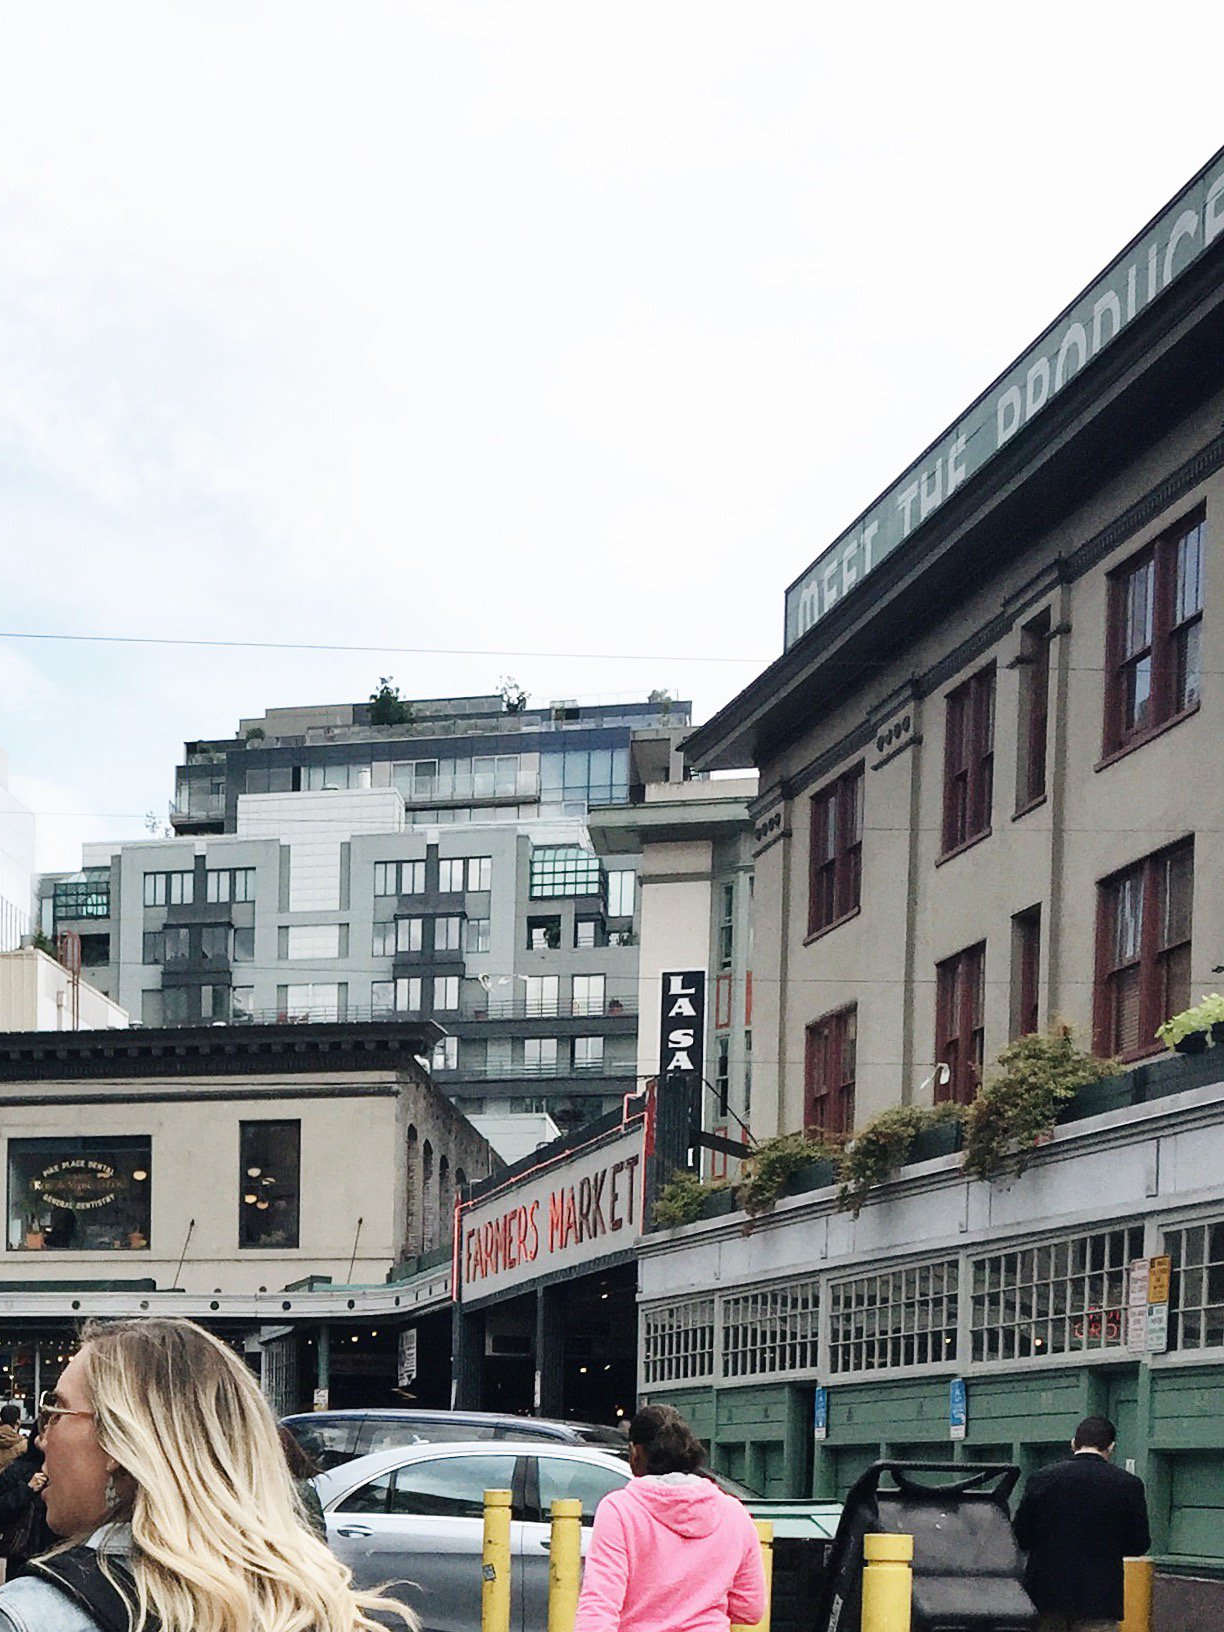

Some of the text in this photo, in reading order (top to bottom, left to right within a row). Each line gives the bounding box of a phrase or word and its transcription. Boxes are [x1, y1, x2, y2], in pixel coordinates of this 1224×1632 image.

[797, 519, 879, 638] MEET
[897, 433, 967, 538] THE
[42, 1159, 115, 1178] PIKE PLACE DENTAL
[42, 1193, 116, 1210] GENERAL DENTISTRY
[465, 1153, 640, 1284] FARMERS MARKET
